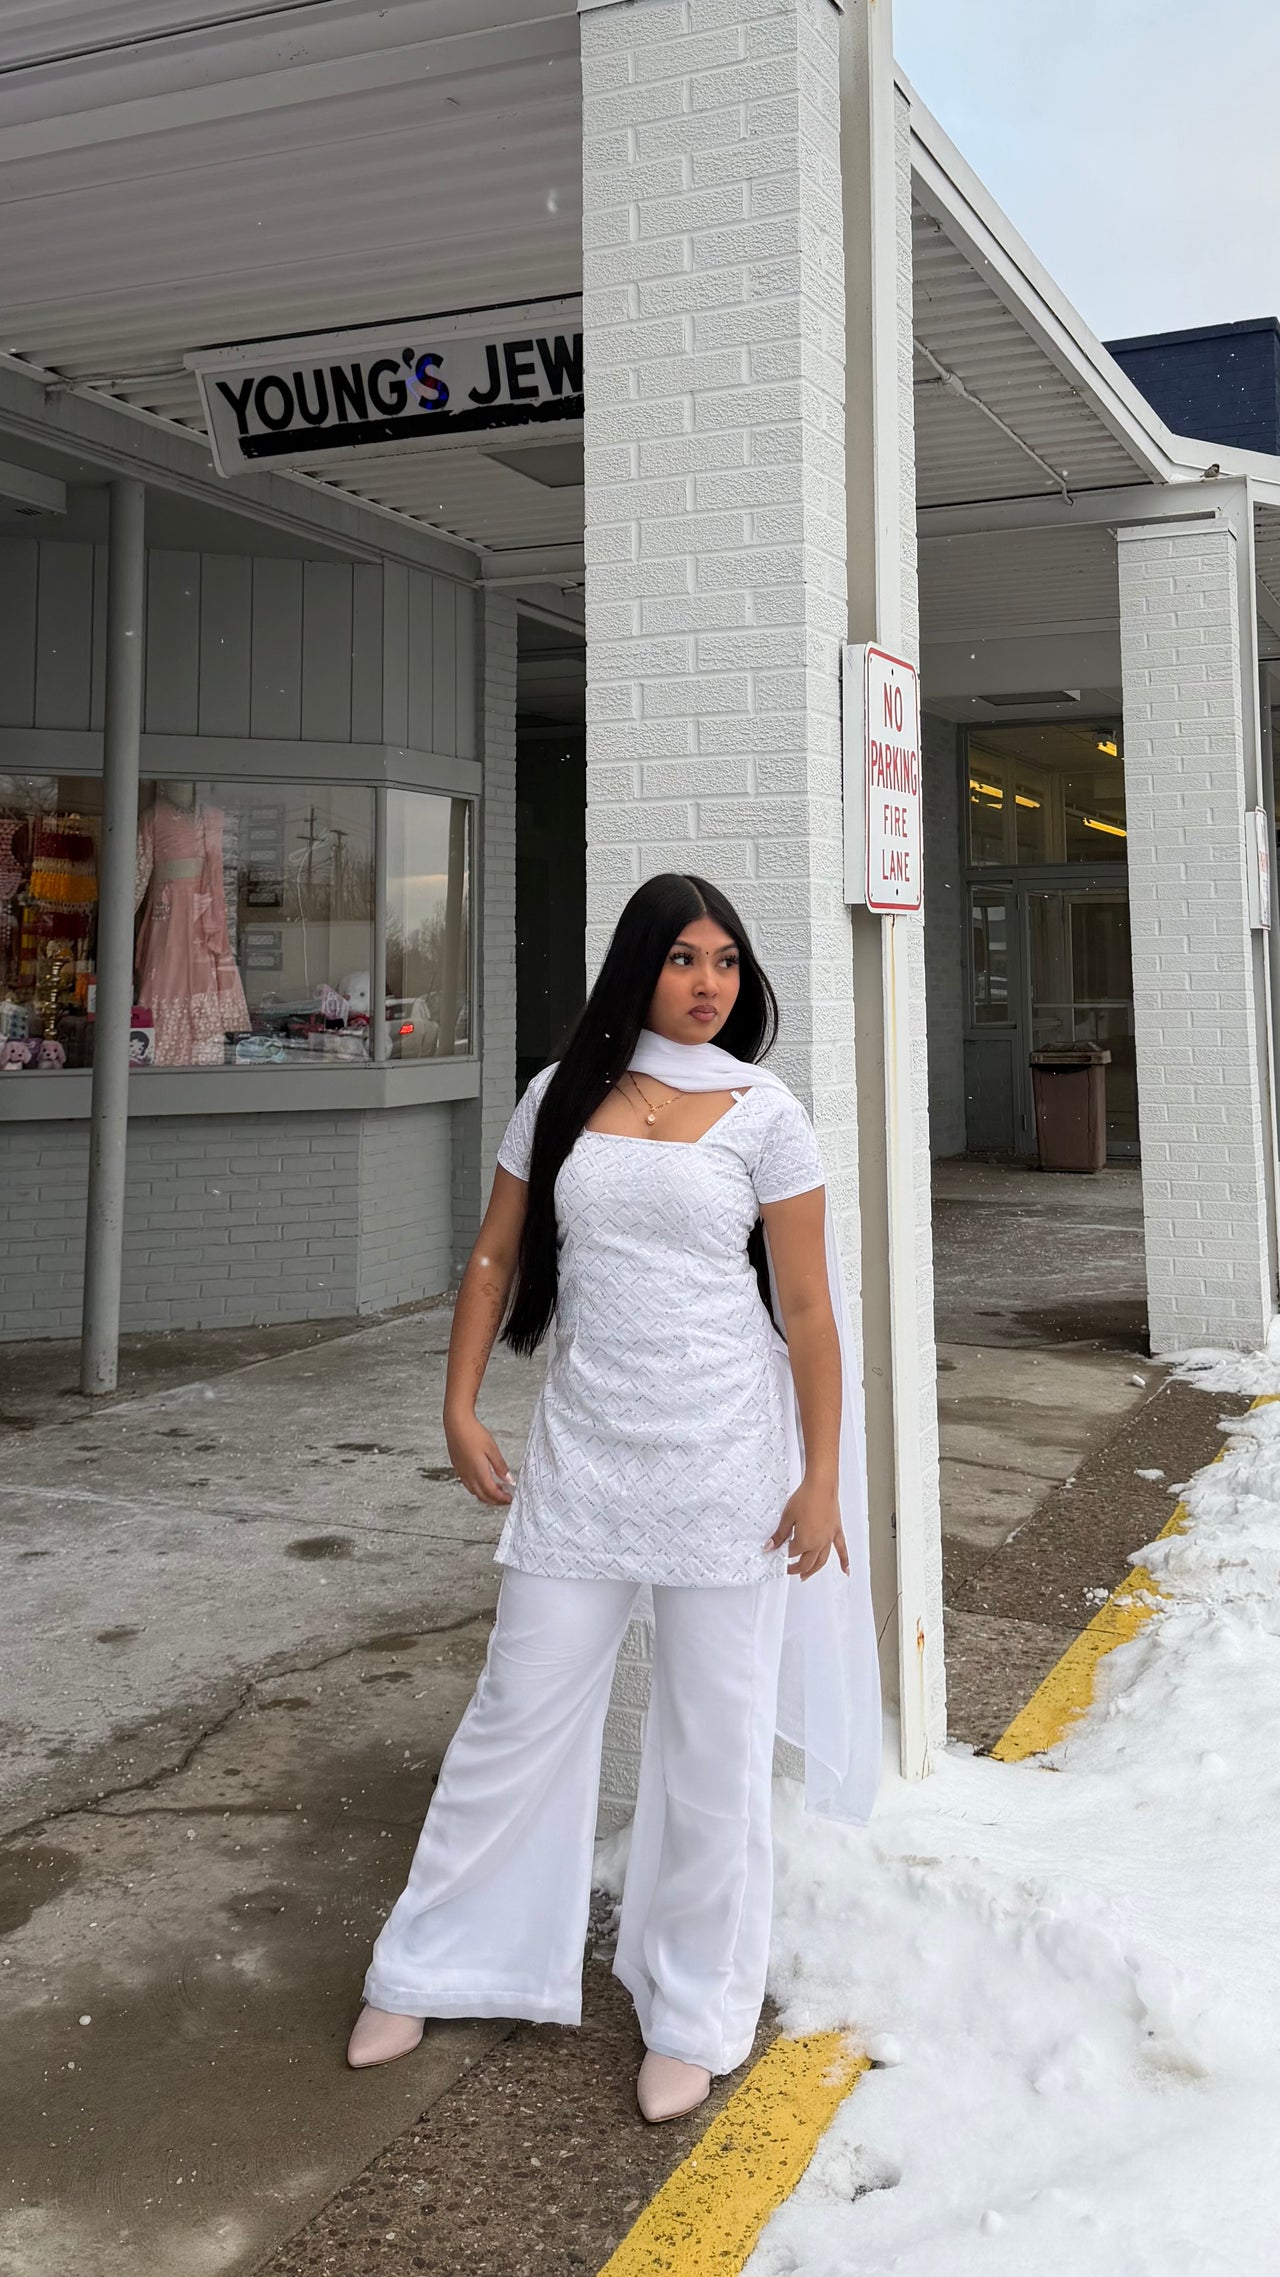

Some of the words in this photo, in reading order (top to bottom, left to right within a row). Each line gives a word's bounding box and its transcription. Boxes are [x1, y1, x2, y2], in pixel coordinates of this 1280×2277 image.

[215, 348, 449, 435] YOUNG'S
[468, 333, 583, 404] JEW
[884, 682, 903, 732] NO
[871, 740, 917, 796] PARKING
[884, 804, 907, 838] FIRE
[882, 849, 910, 882] LANE
